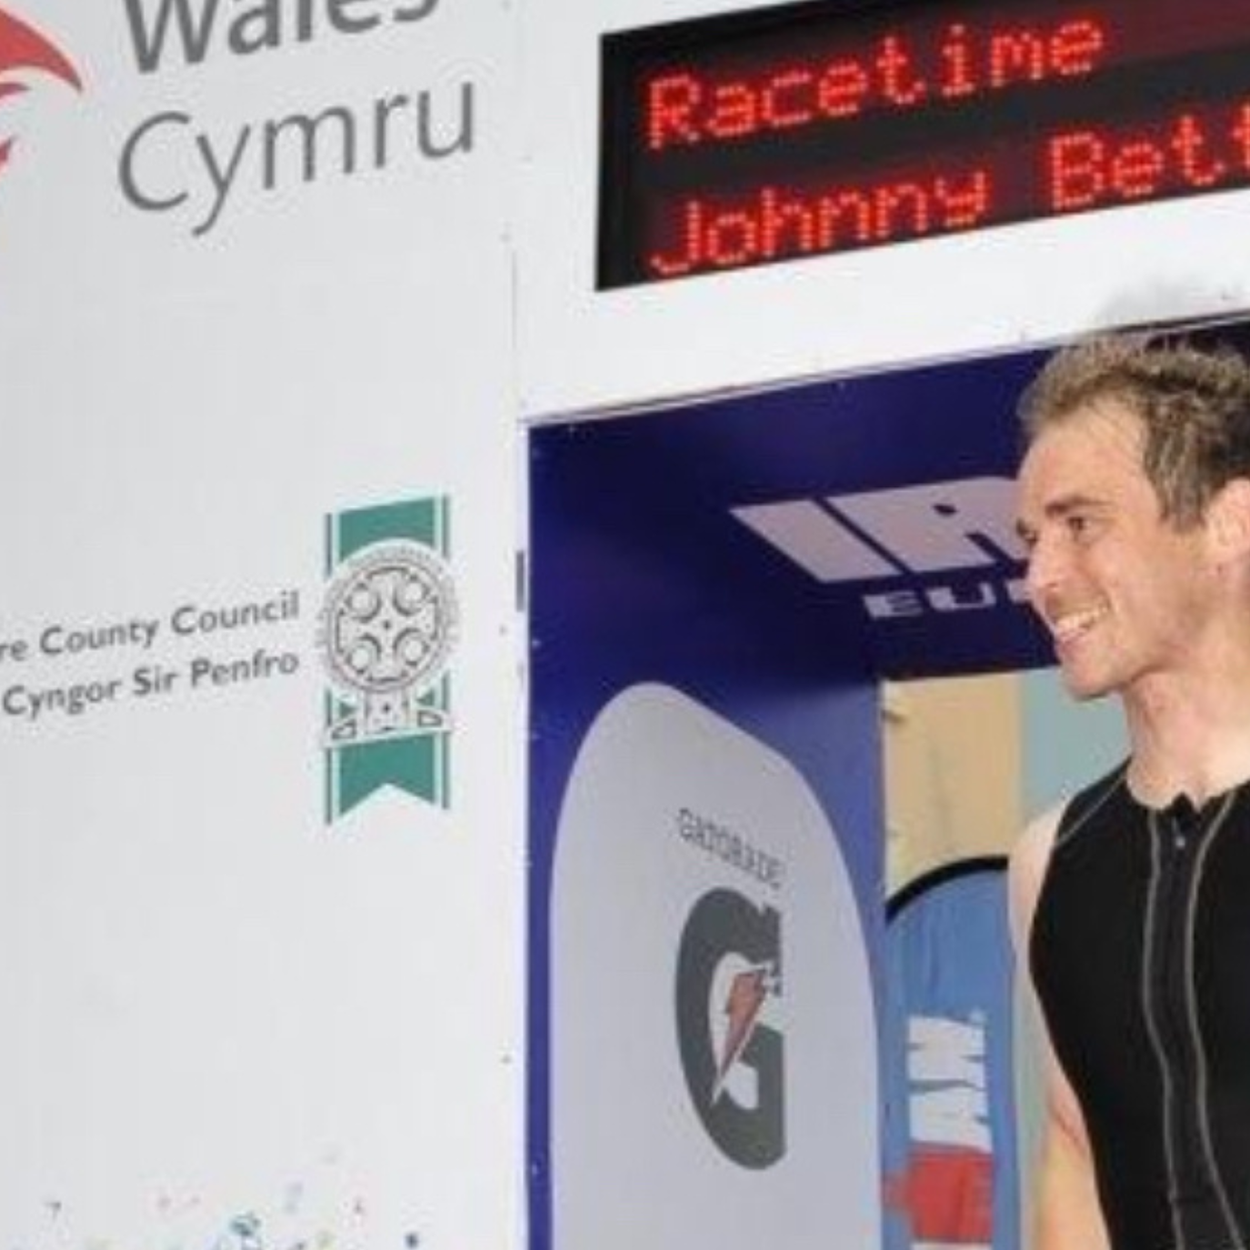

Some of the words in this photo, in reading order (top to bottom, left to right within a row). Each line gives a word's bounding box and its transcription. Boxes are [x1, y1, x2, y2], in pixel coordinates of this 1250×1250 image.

[646, 18, 1106, 149] Racetime
[117, 80, 475, 237] Cymru
[647, 166, 991, 275] Johnny
[40, 617, 159, 656] County
[171, 590, 300, 636] Council
[2, 680, 121, 720] Cyngor
[133, 664, 178, 698] Sir
[191, 647, 300, 689] Penfro
